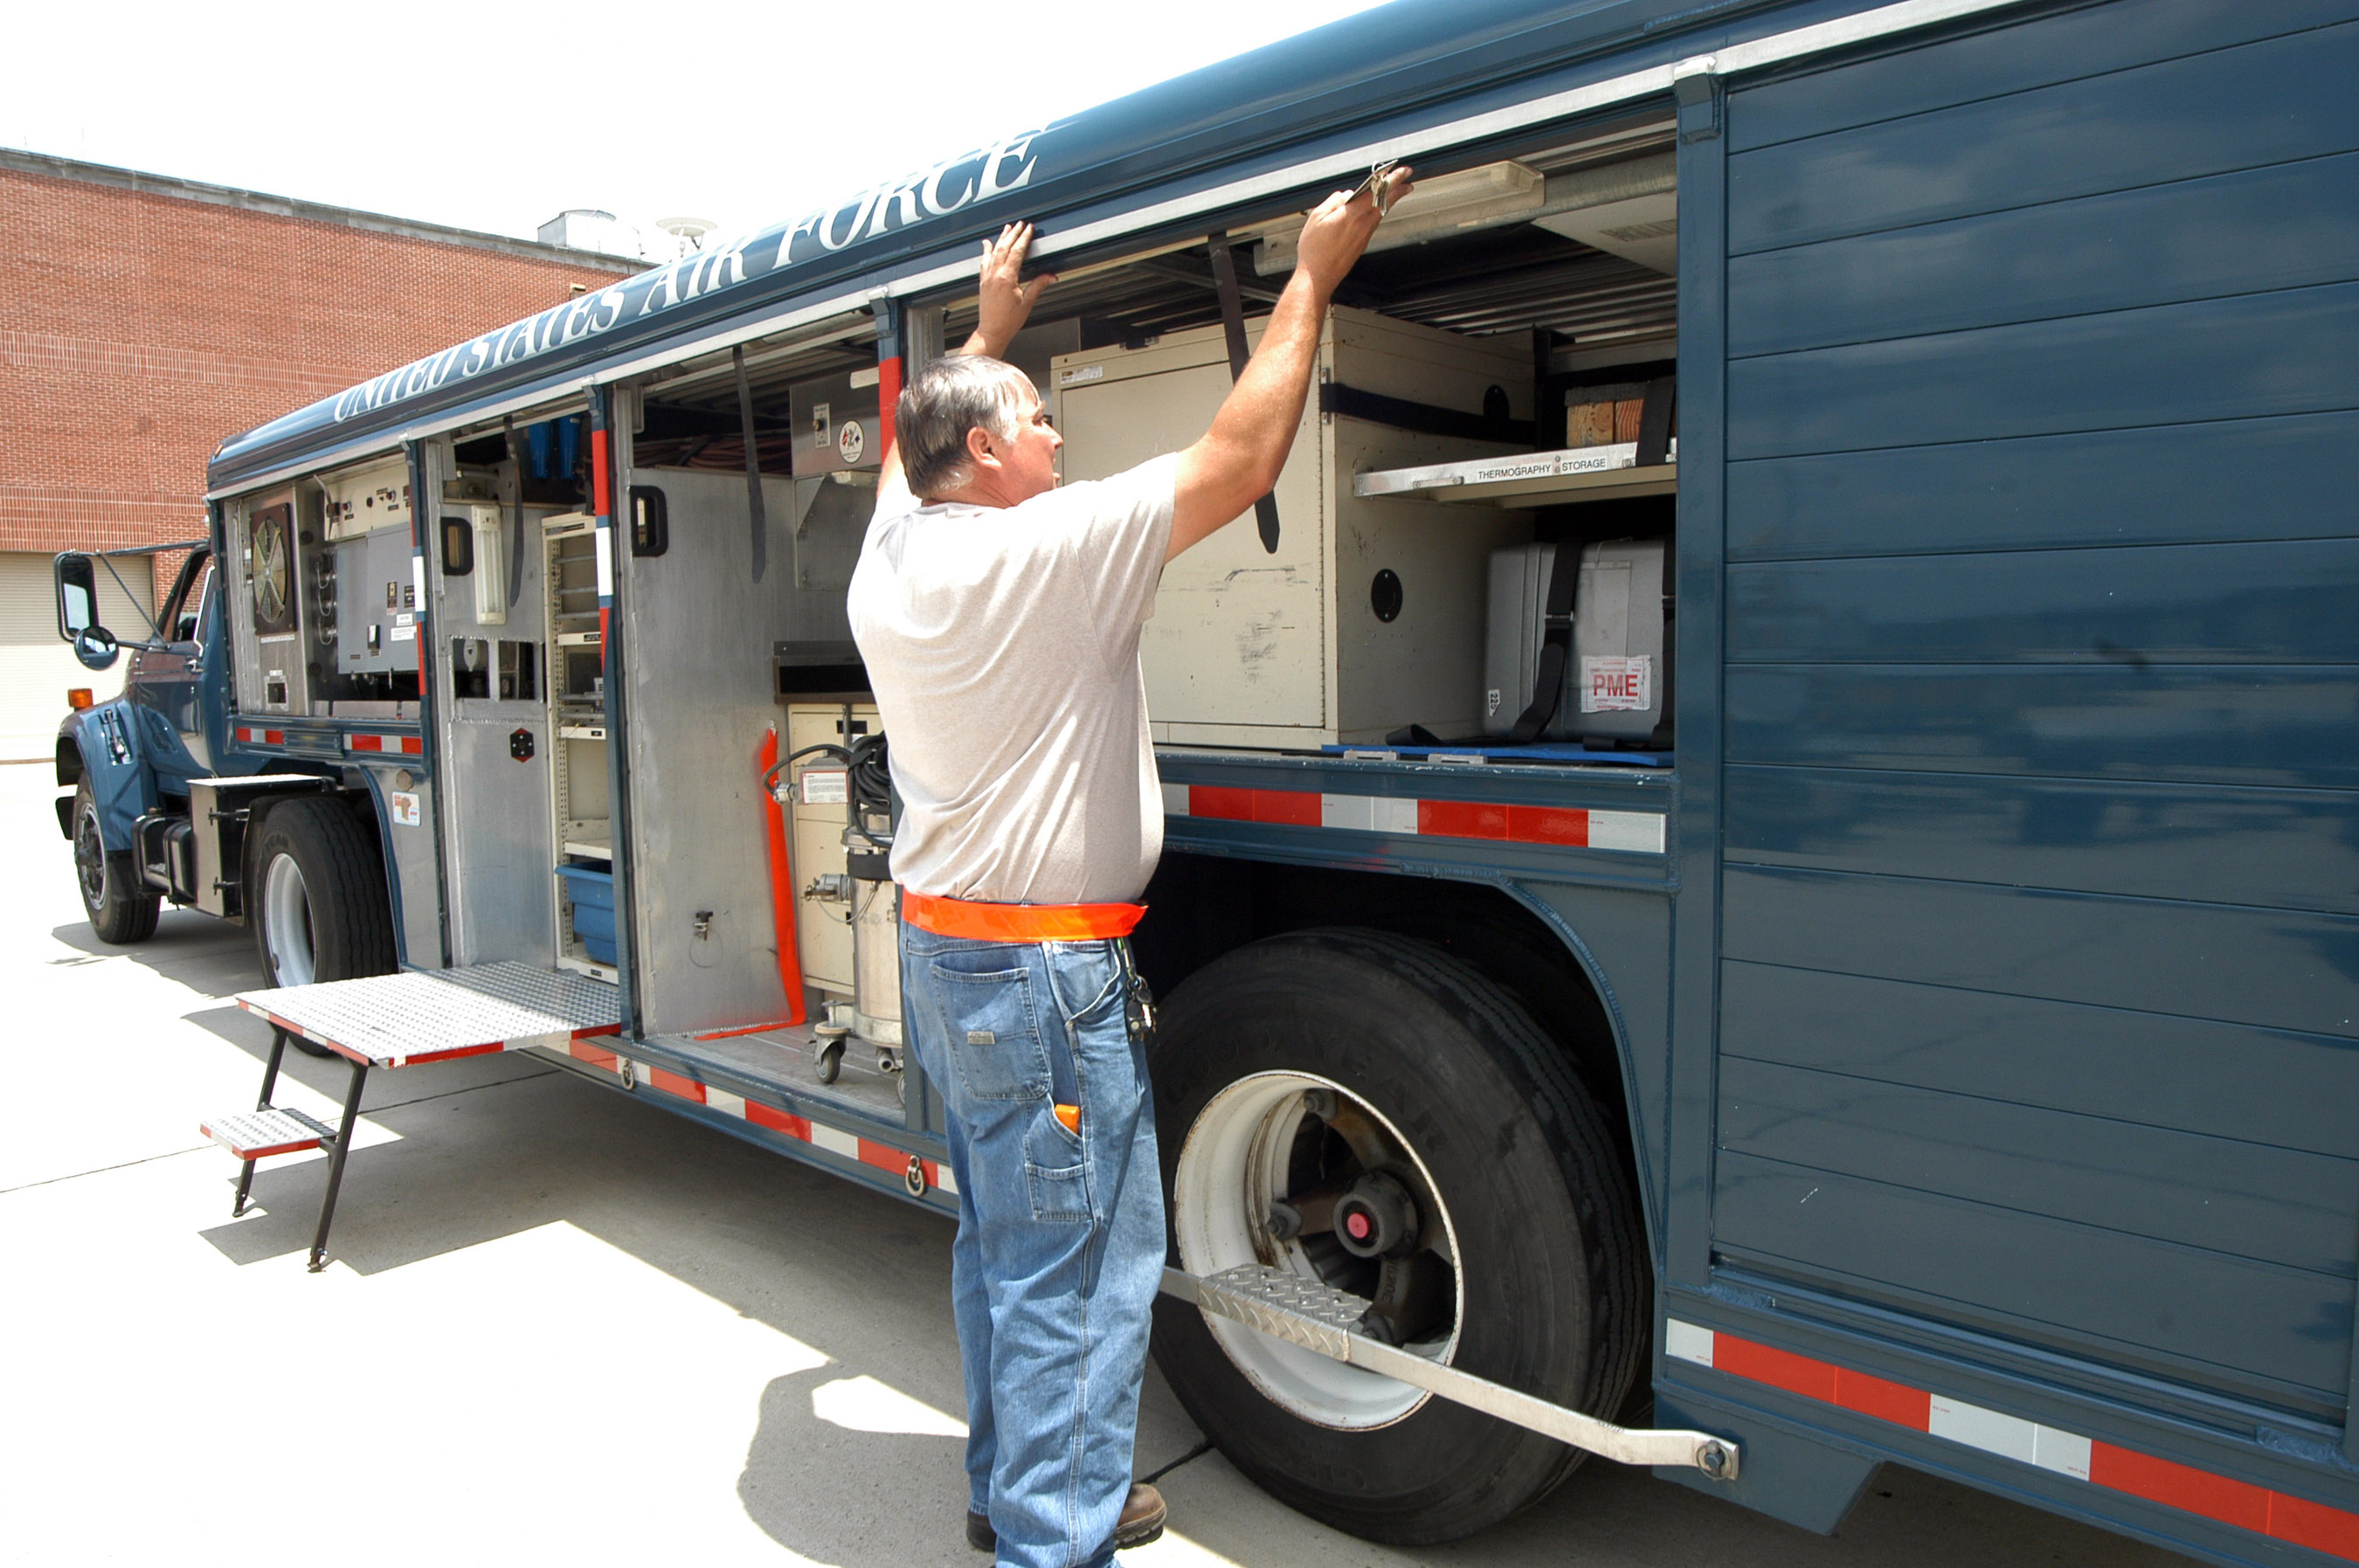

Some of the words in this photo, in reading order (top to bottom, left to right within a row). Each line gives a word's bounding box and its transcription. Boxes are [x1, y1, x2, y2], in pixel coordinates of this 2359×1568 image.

[462, 281, 629, 376] STATES
[639, 236, 754, 316] AIR
[772, 129, 1041, 271] FORCE
[1478, 464, 1552, 480] THERMOGRAPHY
[1562, 458, 1607, 473] STORAGE
[1593, 673, 1639, 697] PME
